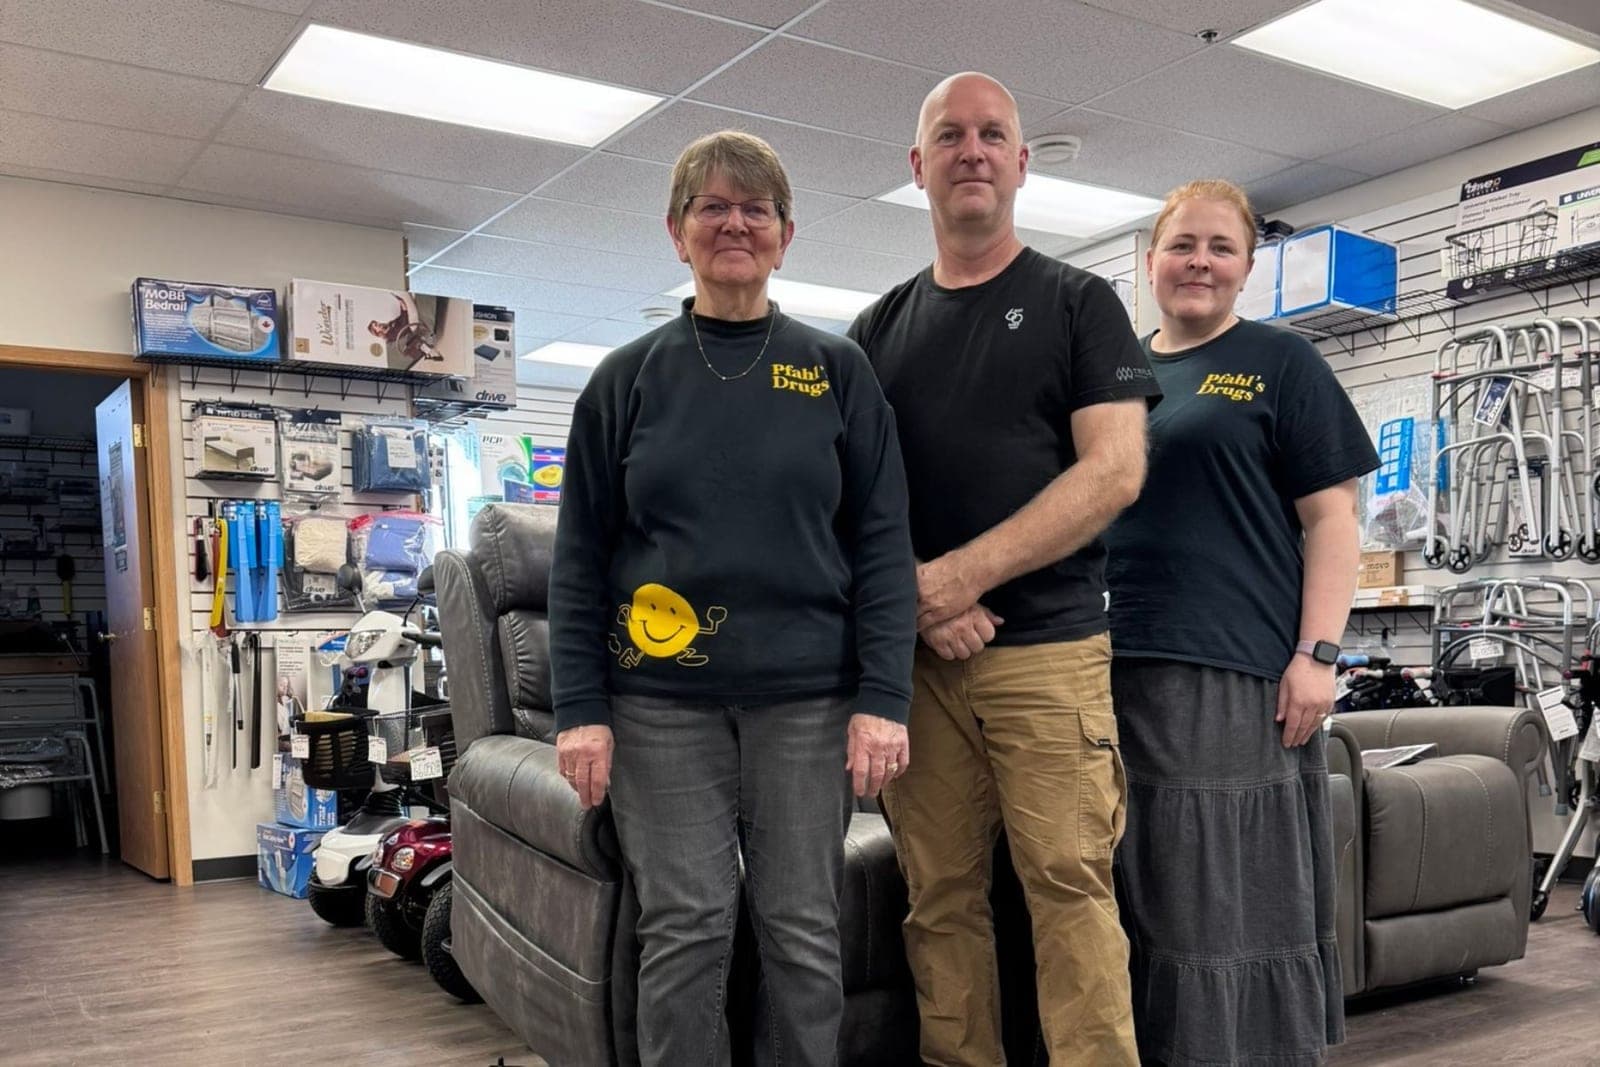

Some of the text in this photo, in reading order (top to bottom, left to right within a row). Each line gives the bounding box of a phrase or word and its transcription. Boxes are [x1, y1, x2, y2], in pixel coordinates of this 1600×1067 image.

[144, 289, 186, 301] MOBB
[144, 299, 188, 312] Bedrail
[772, 363, 827, 380] Pfahl'
[772, 375, 830, 397] Drugs
[1204, 372, 1266, 393] Pfahl's
[475, 389, 507, 402] drive
[1196, 383, 1254, 401] Drugs
